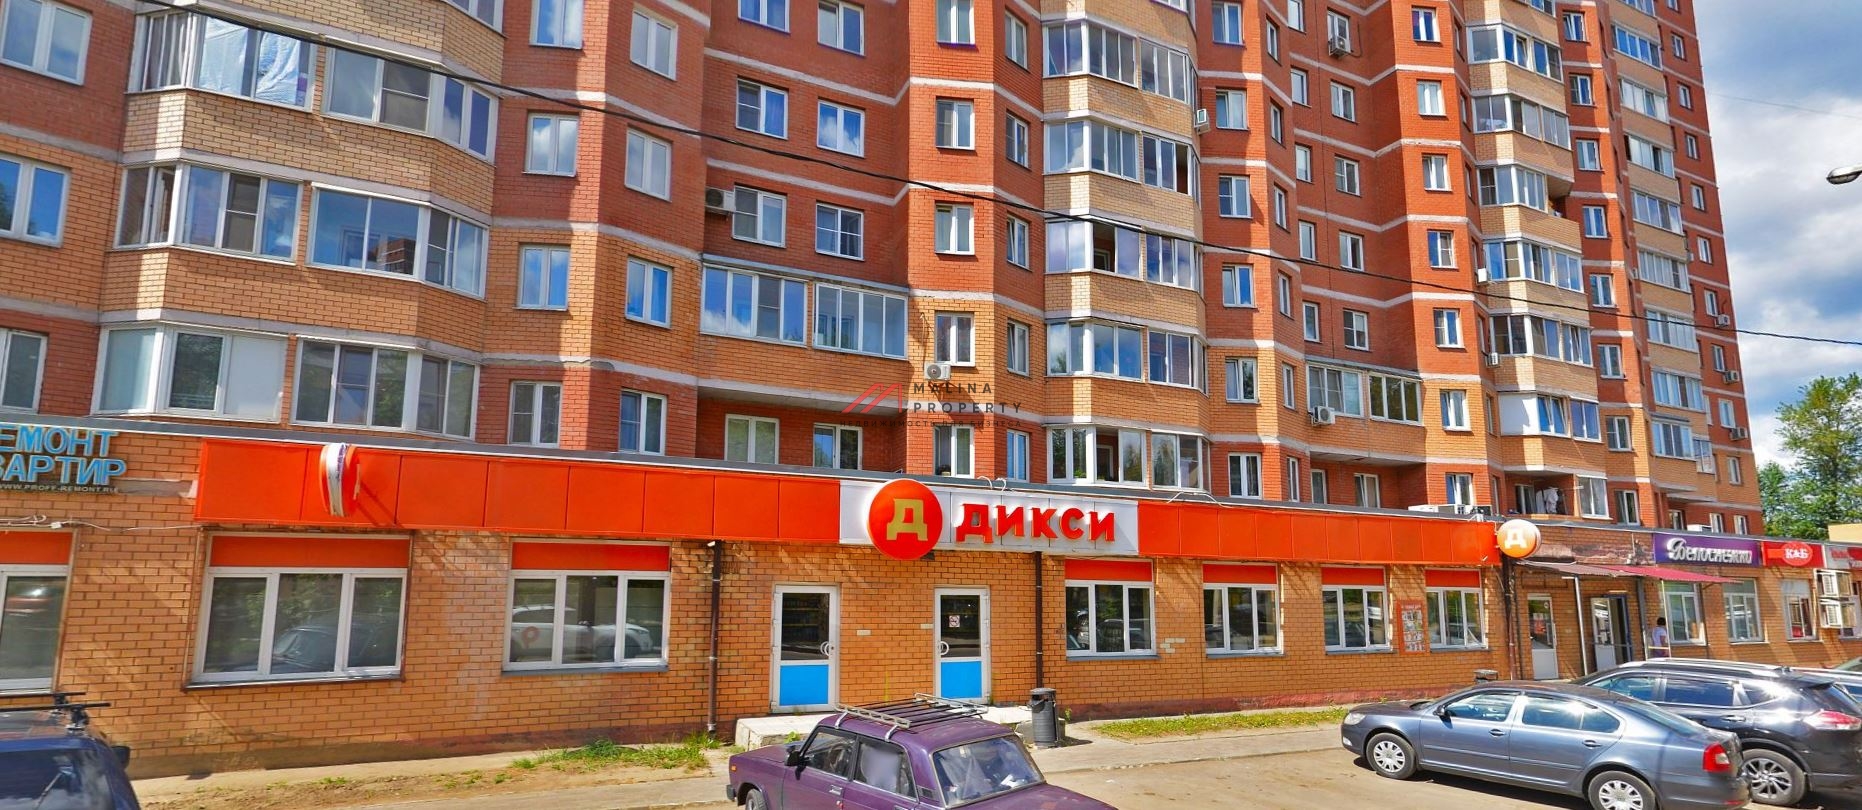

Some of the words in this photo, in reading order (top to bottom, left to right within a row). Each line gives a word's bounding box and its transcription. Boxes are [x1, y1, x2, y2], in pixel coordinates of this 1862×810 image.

[0, 453, 127, 485] АРТИР
[886, 498, 928, 542] Д
[955, 503, 1116, 544] ДИКСИ
[1504, 528, 1528, 549] Д
